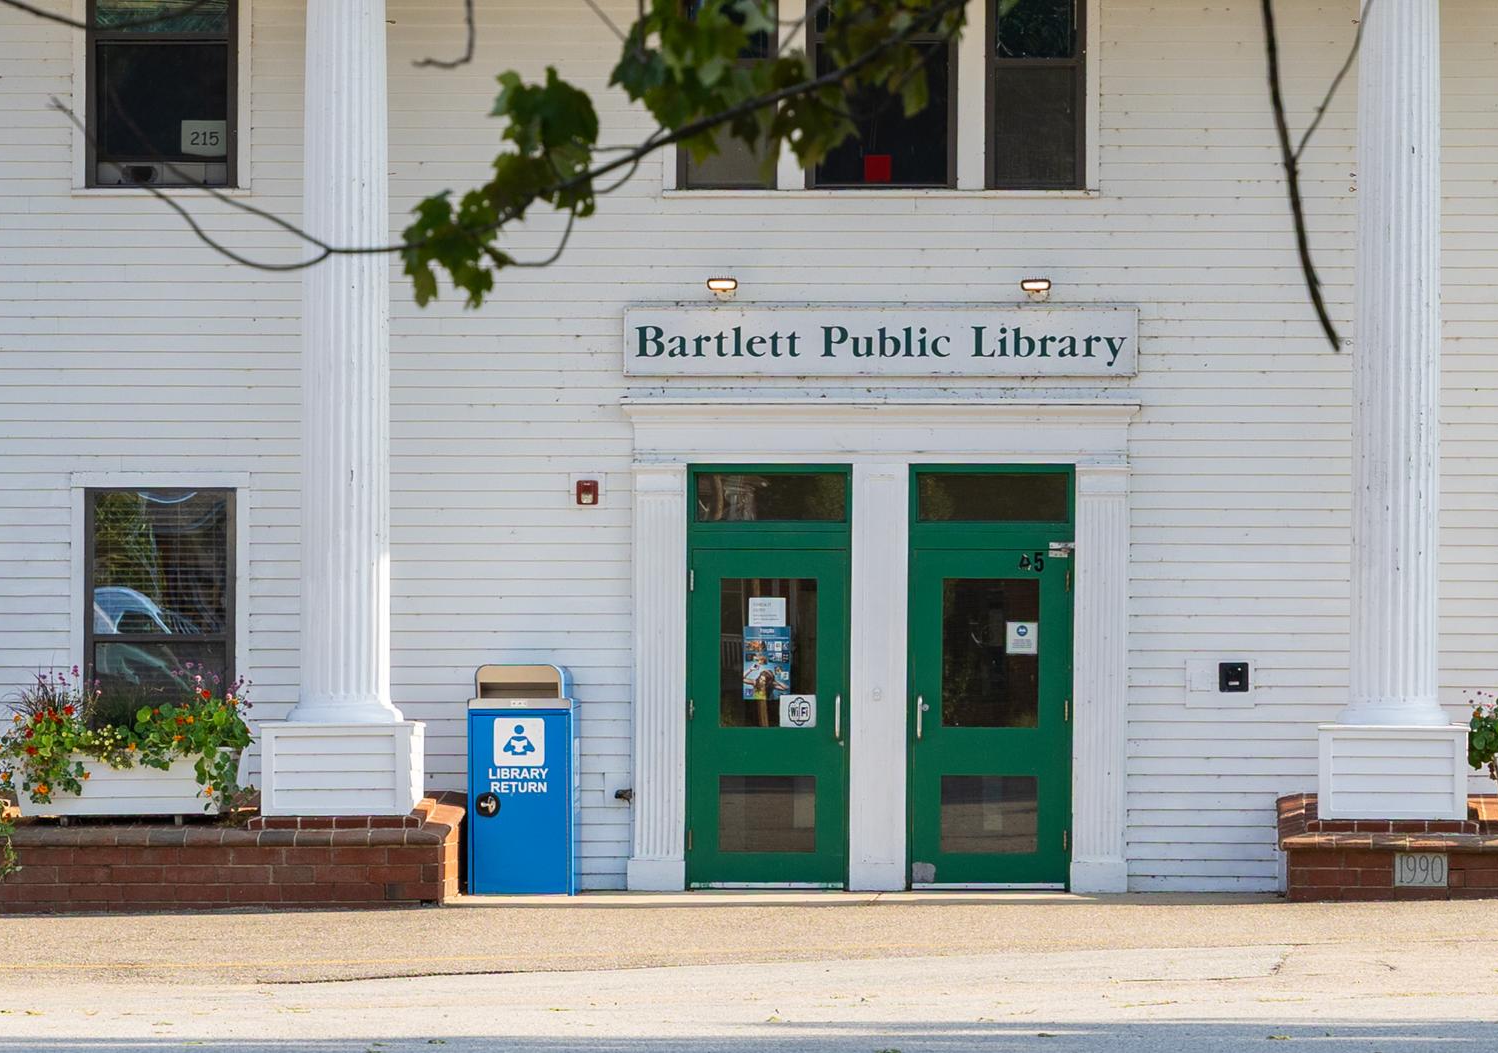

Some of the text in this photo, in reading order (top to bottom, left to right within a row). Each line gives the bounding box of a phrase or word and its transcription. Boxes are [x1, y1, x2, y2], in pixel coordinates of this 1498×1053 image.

[190, 131, 219, 146] 215
[635, 325, 1128, 367] Bartlett Public Library
[488, 768, 549, 779] LIBRARY
[490, 782, 547, 793] RETURN
[1399, 855, 1443, 883] 1990
